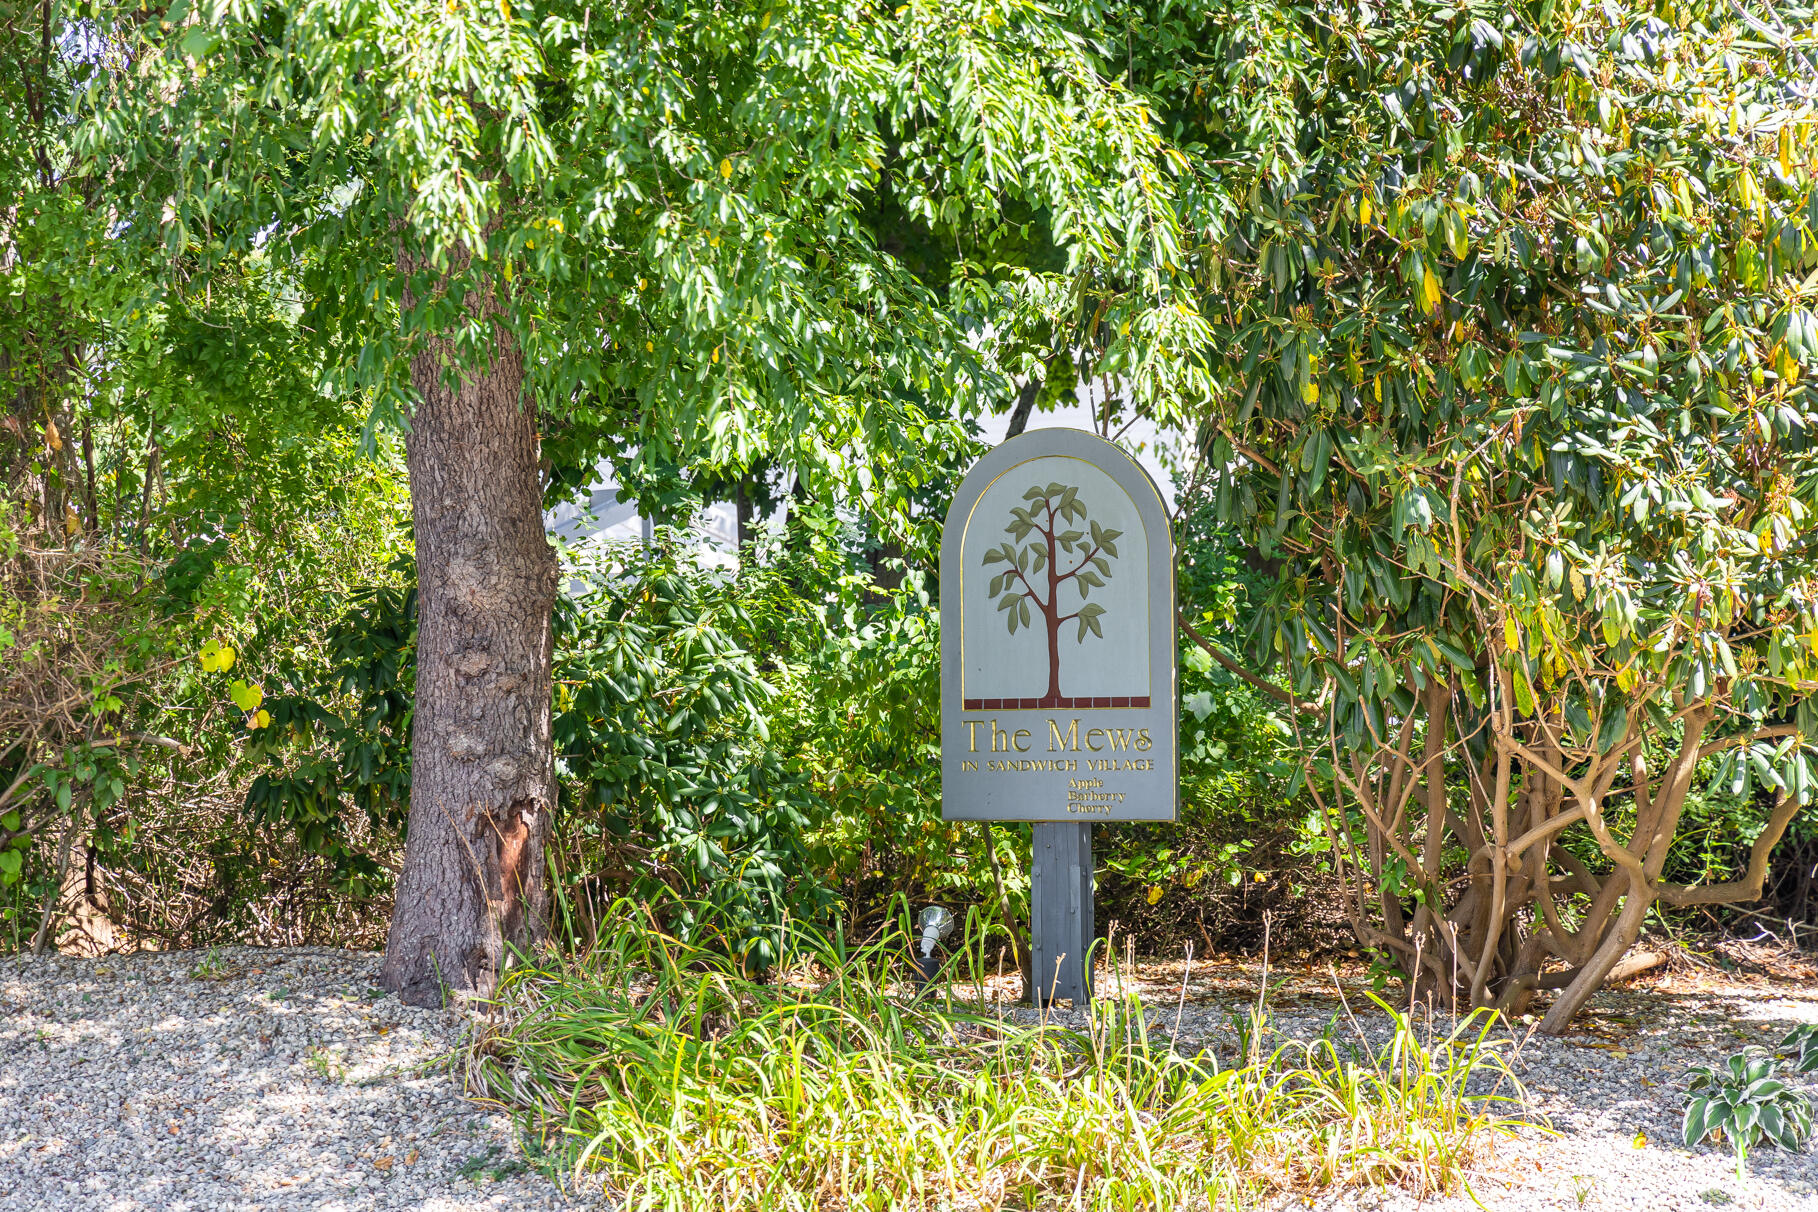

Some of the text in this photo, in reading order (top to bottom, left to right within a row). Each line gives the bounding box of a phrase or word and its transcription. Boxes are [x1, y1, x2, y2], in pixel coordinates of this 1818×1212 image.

[961, 718, 1153, 753] The Mews
[961, 759, 1154, 772] IN SANDWICH VILLAGE
[1067, 777, 1104, 790] Apple
[1067, 790, 1127, 803] Barberry
